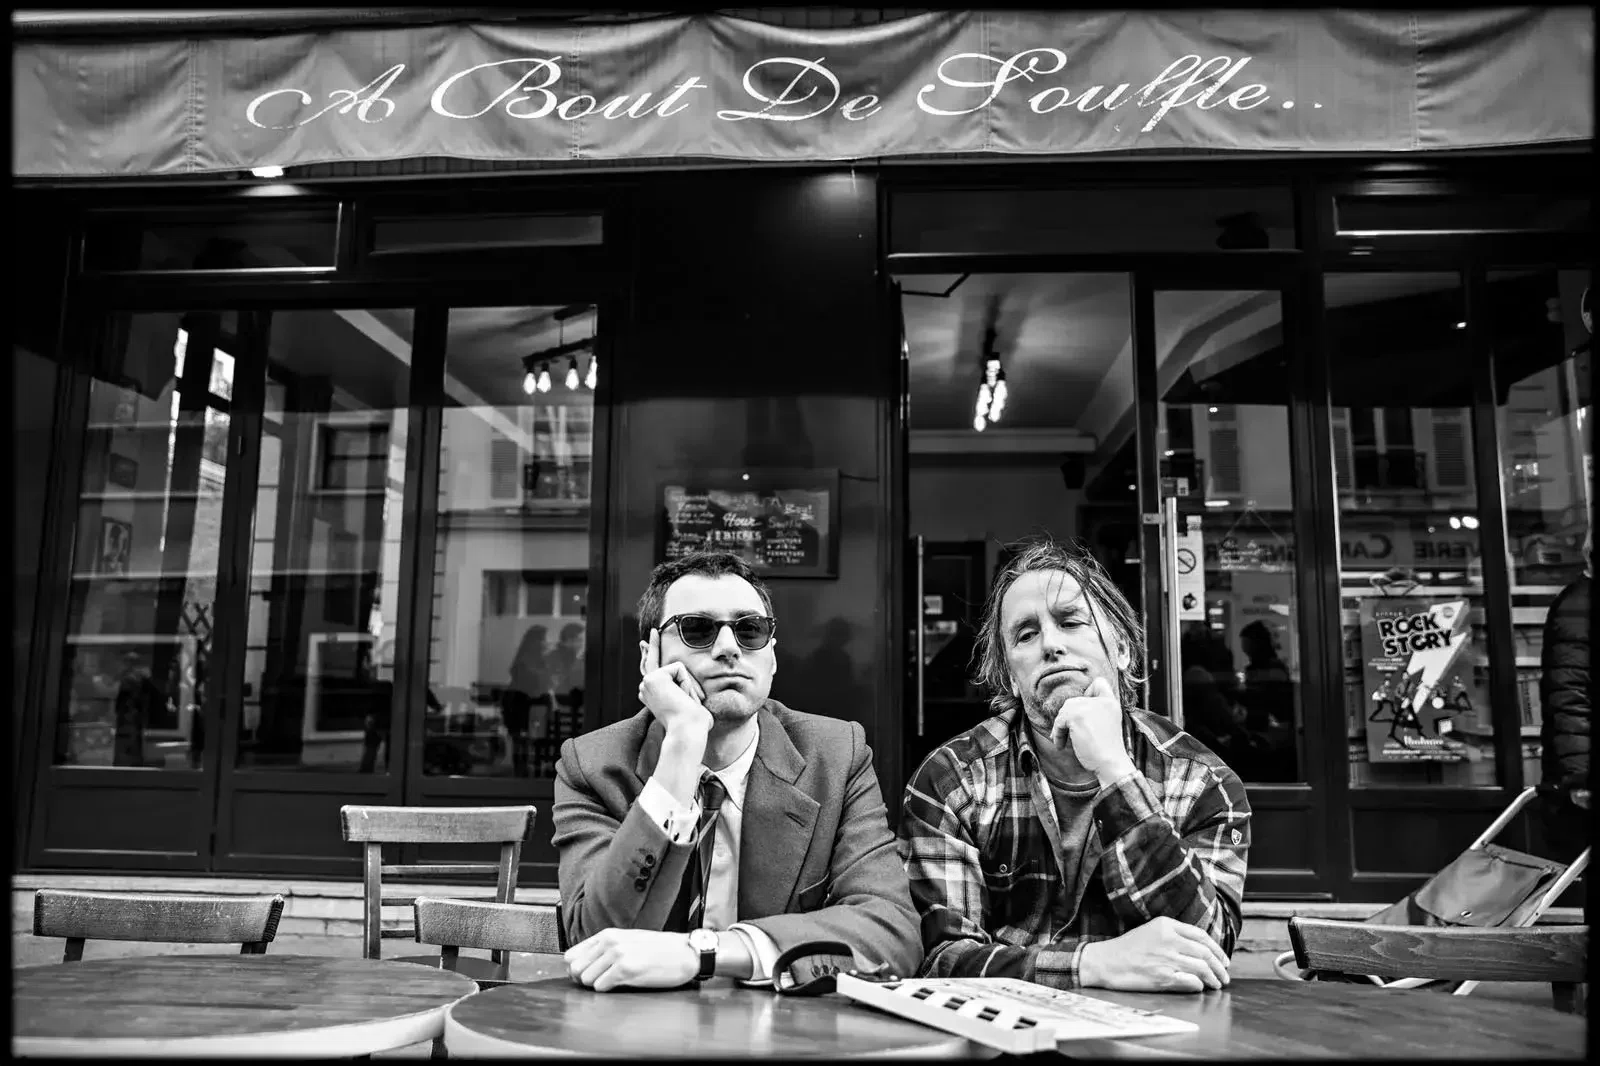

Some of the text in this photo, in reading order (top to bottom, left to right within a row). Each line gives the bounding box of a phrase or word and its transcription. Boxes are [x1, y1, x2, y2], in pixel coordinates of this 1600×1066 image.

[246, 63, 406, 129] A
[431, 55, 708, 121] Bout
[717, 57, 883, 122] De
[722, 512, 763, 528] Hour
[1378, 612, 1440, 639] ROCK
[1383, 629, 1452, 657] STORY
